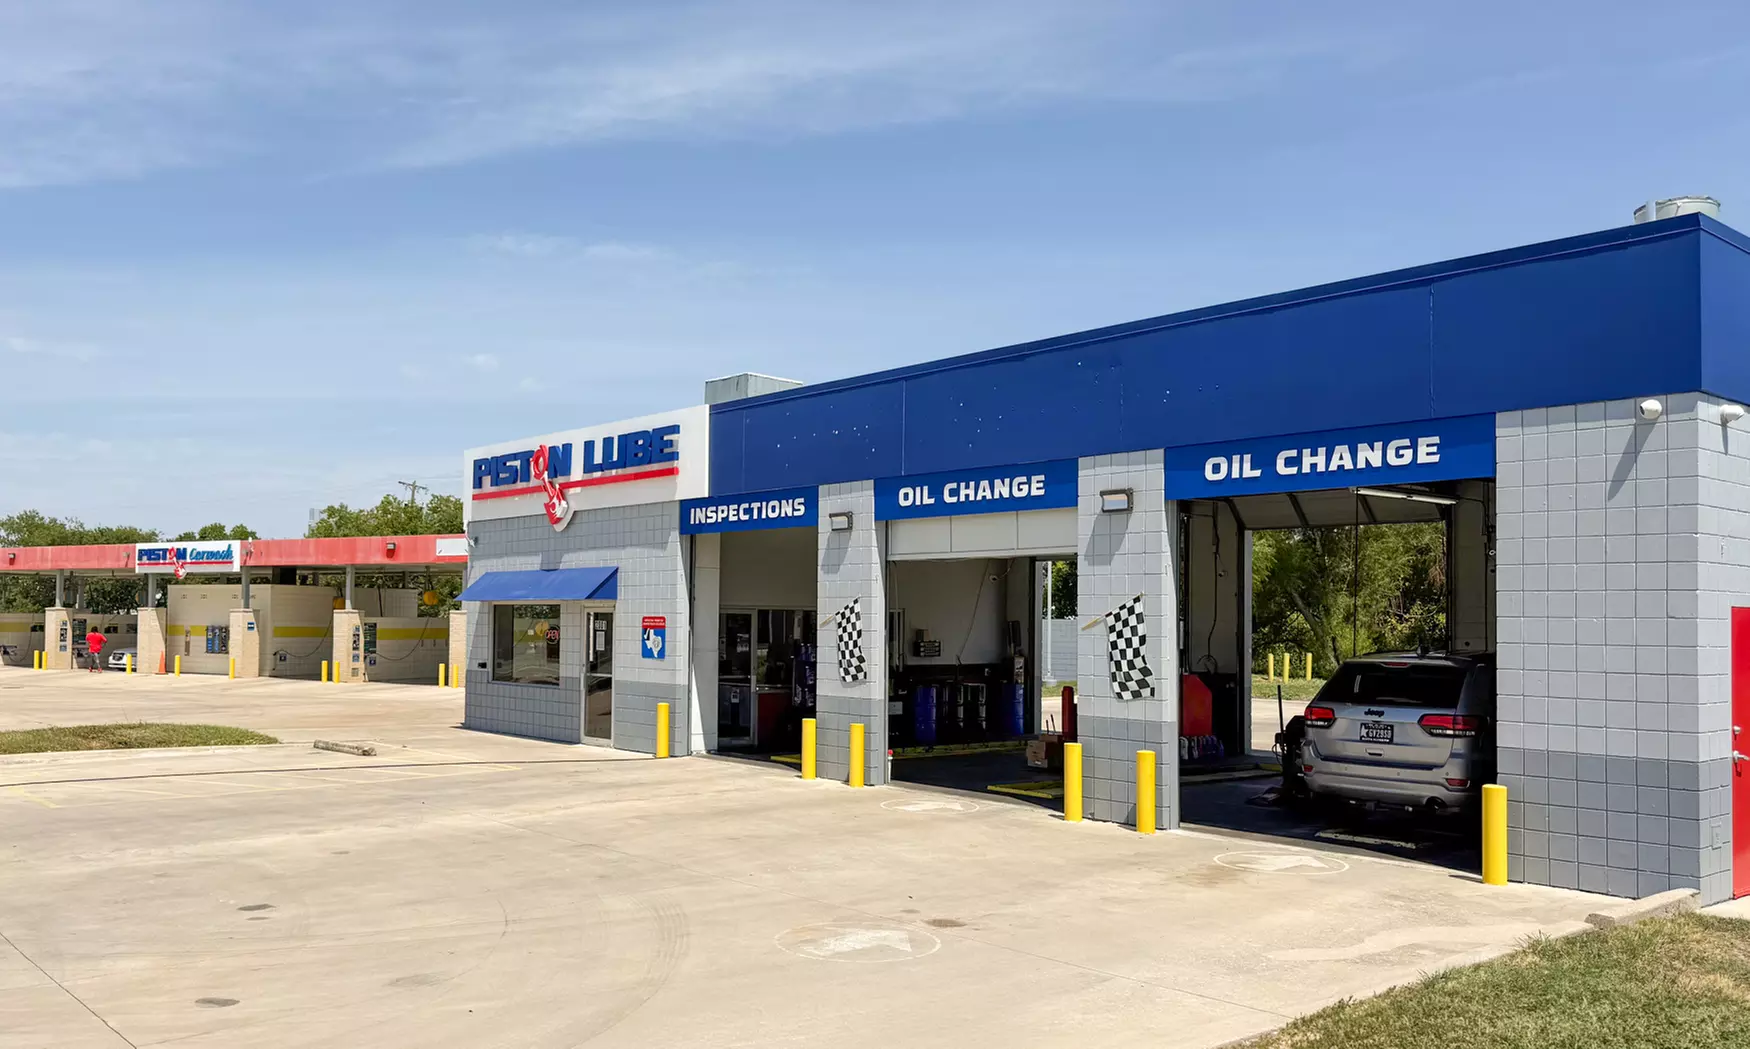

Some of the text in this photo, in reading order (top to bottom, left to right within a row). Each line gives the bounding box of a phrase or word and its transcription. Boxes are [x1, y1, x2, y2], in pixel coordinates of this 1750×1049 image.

[473, 424, 680, 489] PISTON LUBE
[1204, 436, 1441, 481] OIL CHANGE
[898, 475, 1046, 508] OIL CHANGE
[689, 497, 806, 525] INSPECTIONS
[137, 543, 234, 561] PISTON Carwash
[1364, 707, 1385, 717] Jeep
